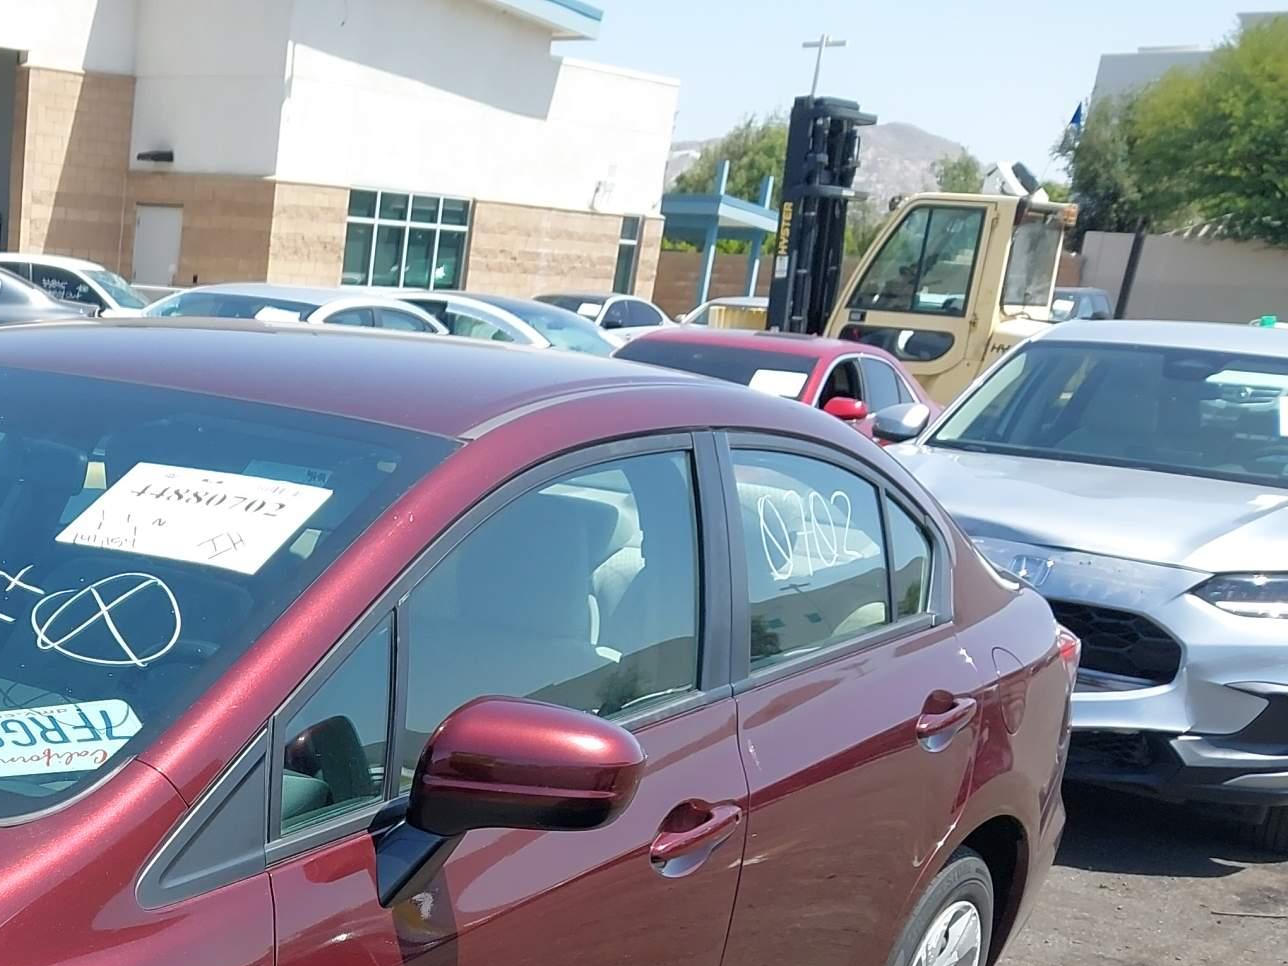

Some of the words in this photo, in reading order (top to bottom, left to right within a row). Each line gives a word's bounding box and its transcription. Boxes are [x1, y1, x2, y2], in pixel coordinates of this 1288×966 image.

[778, 202, 793, 254] HYSTER
[131, 484, 286, 517] 44880702
[758, 490, 865, 581] 0702
